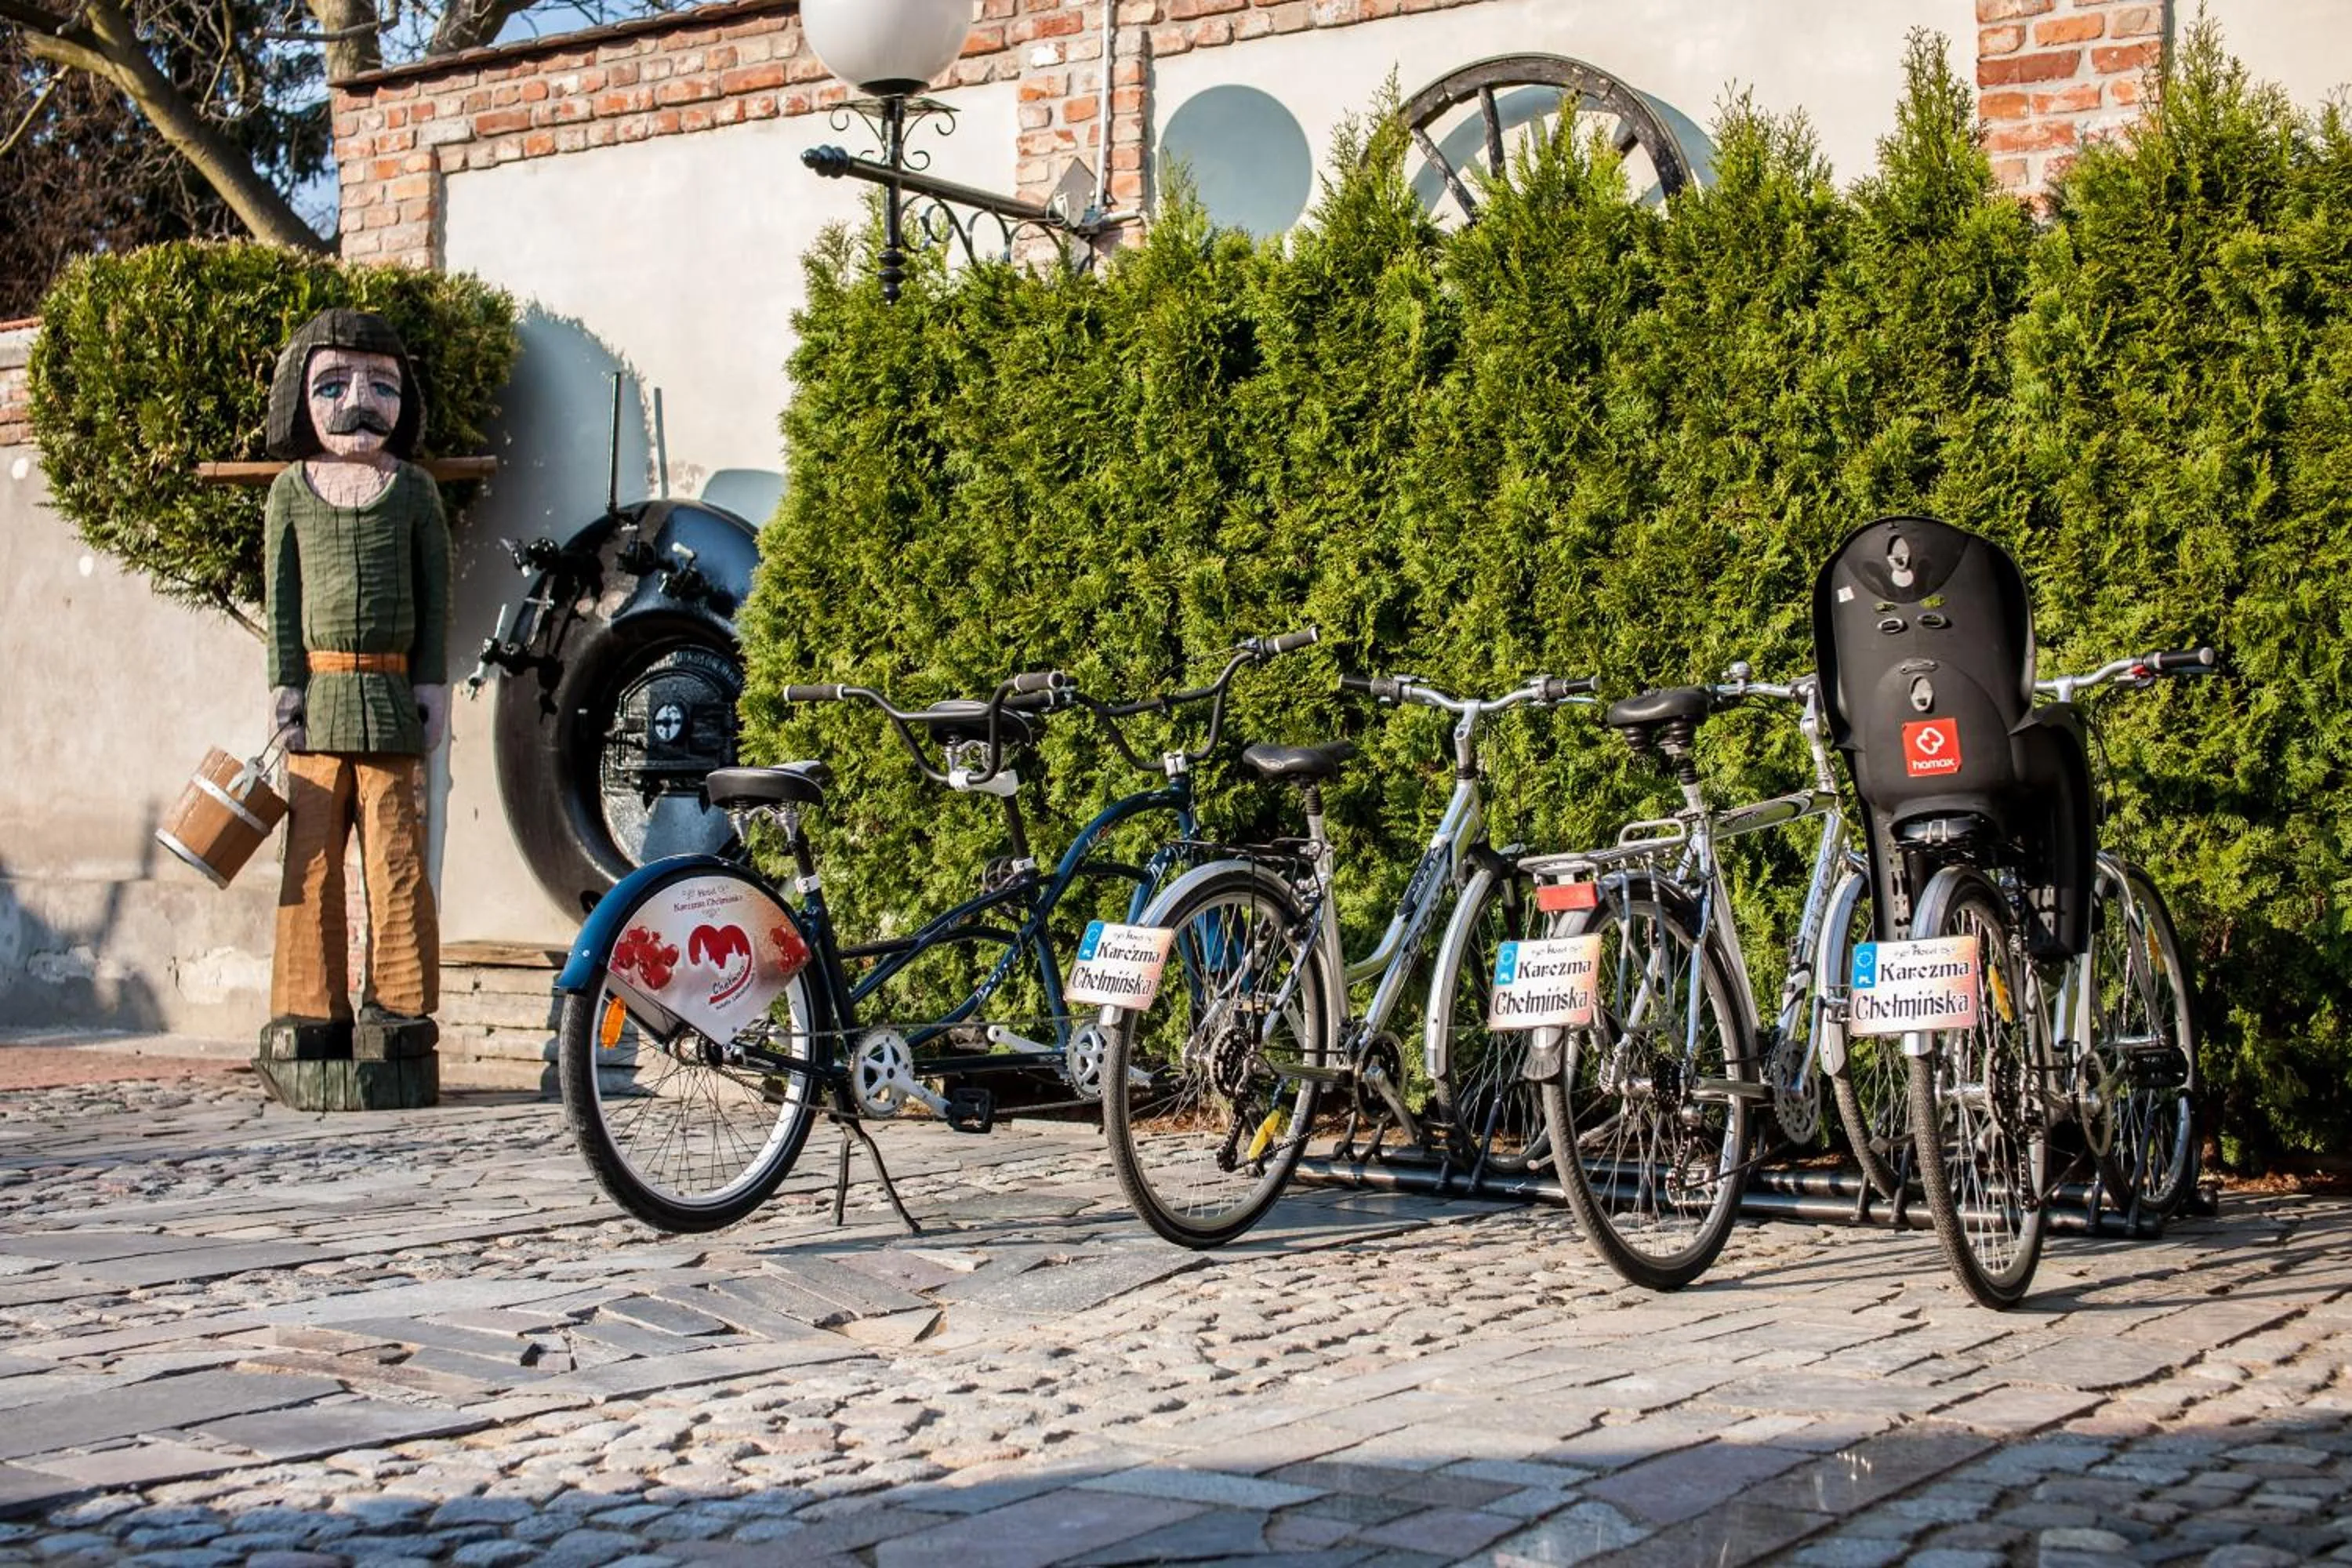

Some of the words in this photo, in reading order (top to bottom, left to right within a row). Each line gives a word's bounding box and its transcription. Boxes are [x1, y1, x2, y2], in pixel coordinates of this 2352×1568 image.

[1912, 758, 1955, 771] hamax
[1098, 942, 1160, 964] Karczma
[1072, 965, 1152, 996] Chełmińska
[1517, 960, 1592, 979] Karczma
[1880, 963, 1969, 982] Karczma
[1494, 985, 1588, 1016] Chełmińska
[1855, 989, 1969, 1021] Chełmińska
